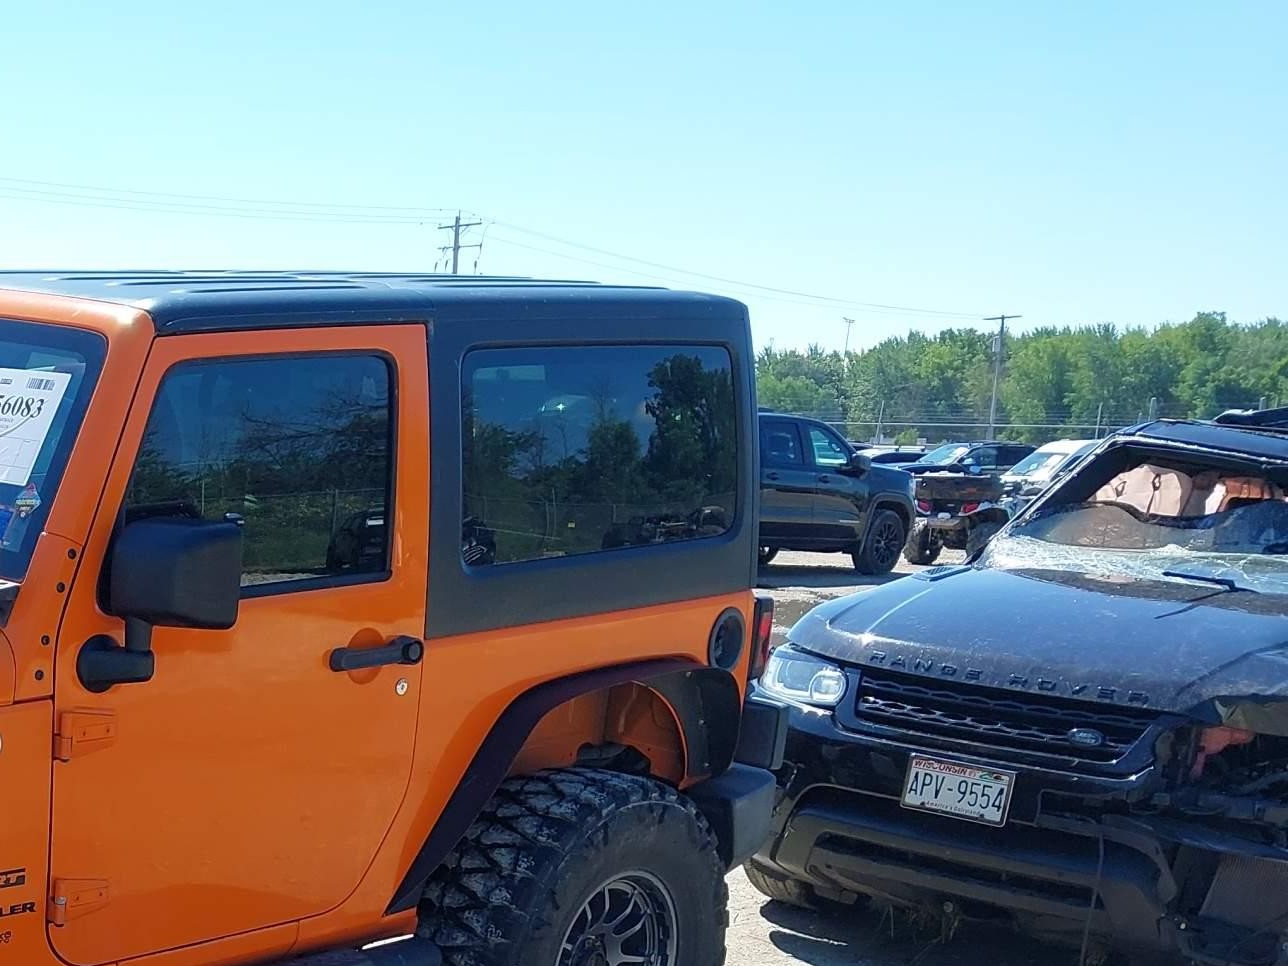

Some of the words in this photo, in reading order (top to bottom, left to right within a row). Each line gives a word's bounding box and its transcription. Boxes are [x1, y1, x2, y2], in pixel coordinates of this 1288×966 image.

[869, 650, 984, 681] RANGE
[1008, 672, 1150, 705] ROVER
[913, 759, 968, 776] WISCONSIN
[908, 771, 1005, 813] APV-9554
